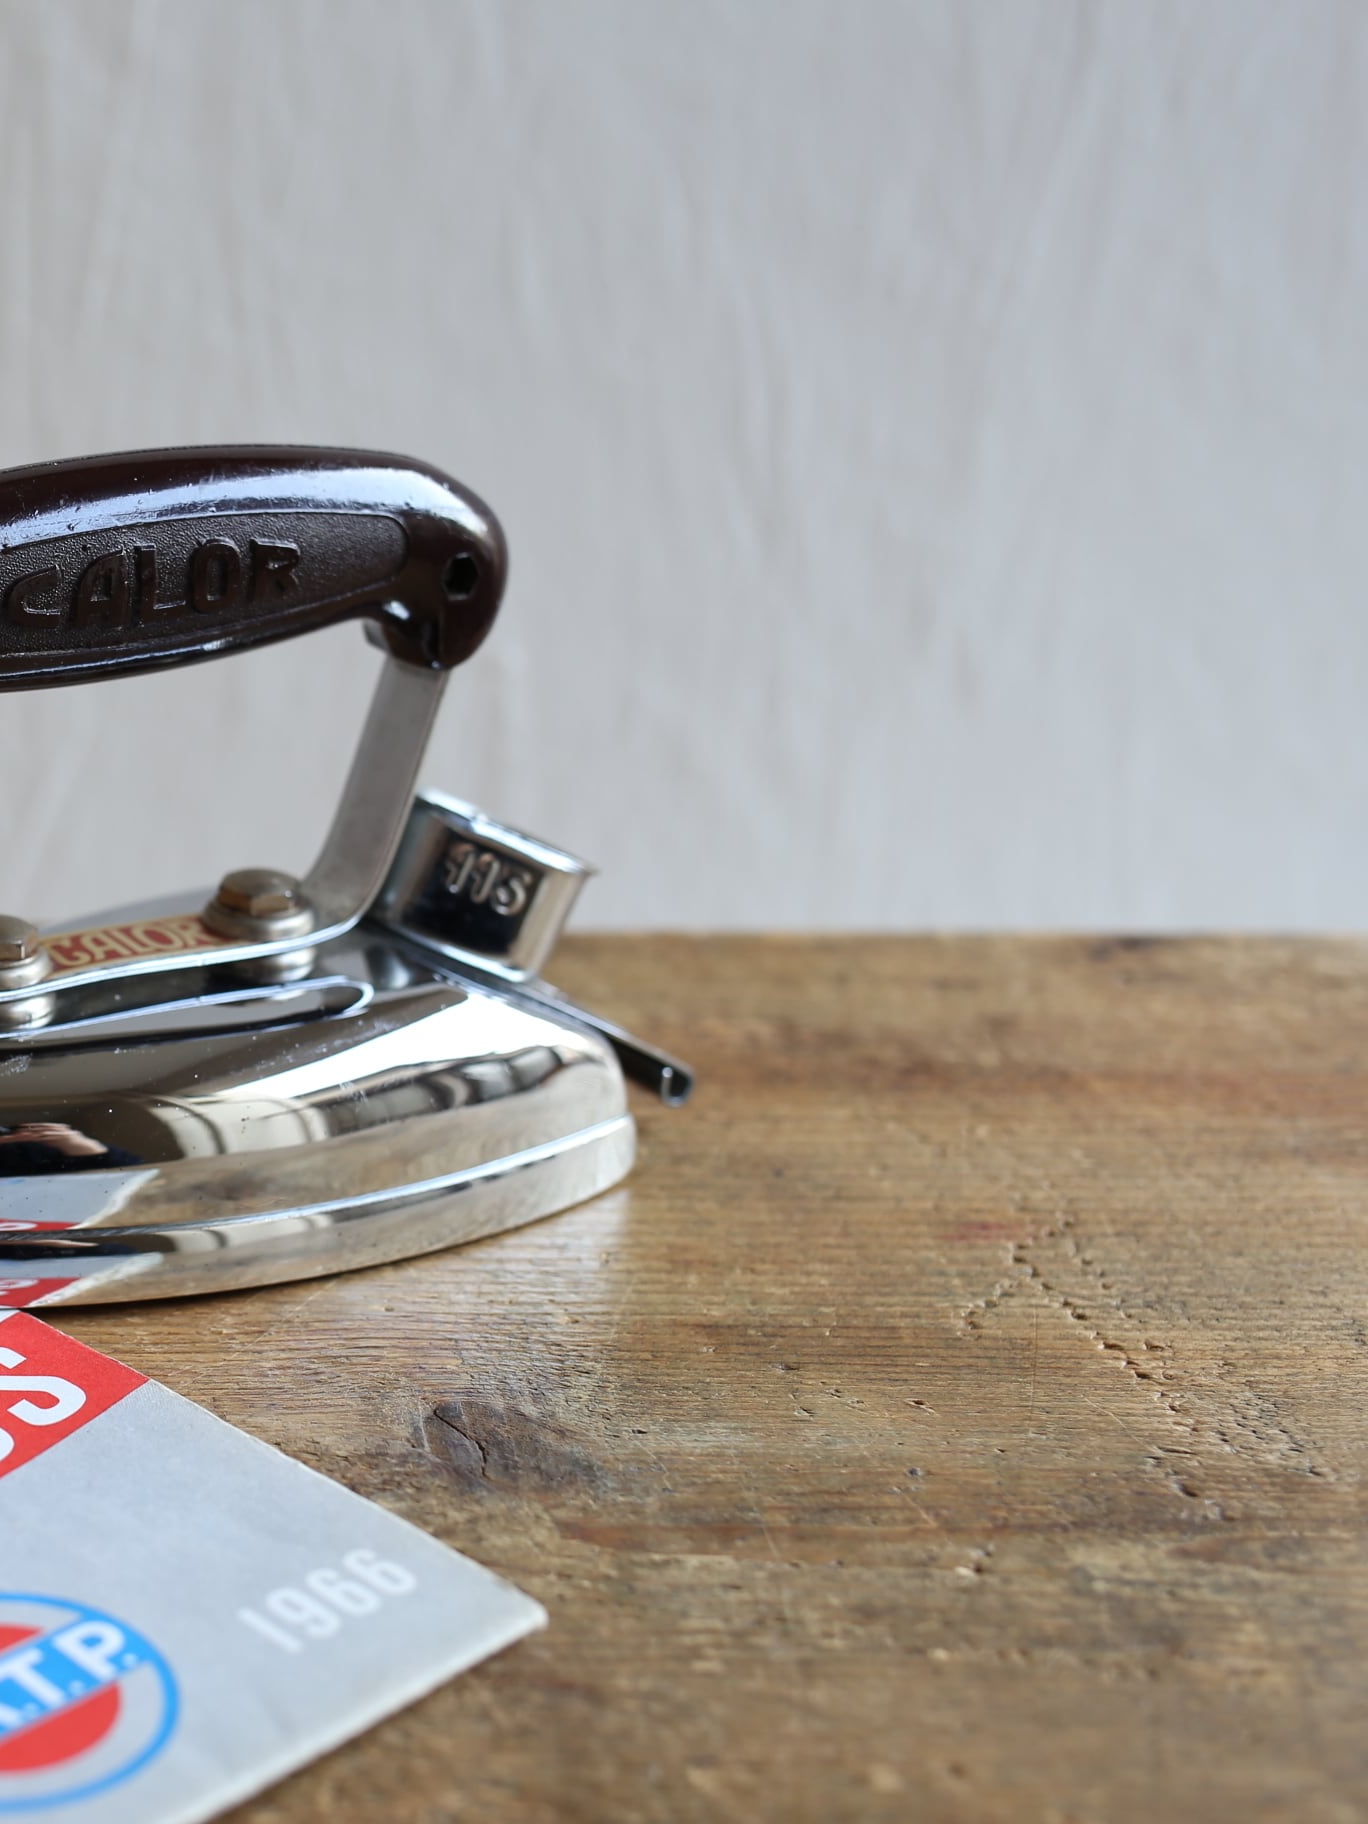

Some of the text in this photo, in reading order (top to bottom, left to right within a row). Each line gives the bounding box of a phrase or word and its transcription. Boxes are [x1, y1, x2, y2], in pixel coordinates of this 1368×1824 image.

[5, 537, 301, 630] CALOR
[49, 921, 216, 967] CALOR
[237, 1547, 418, 1655] 1966
